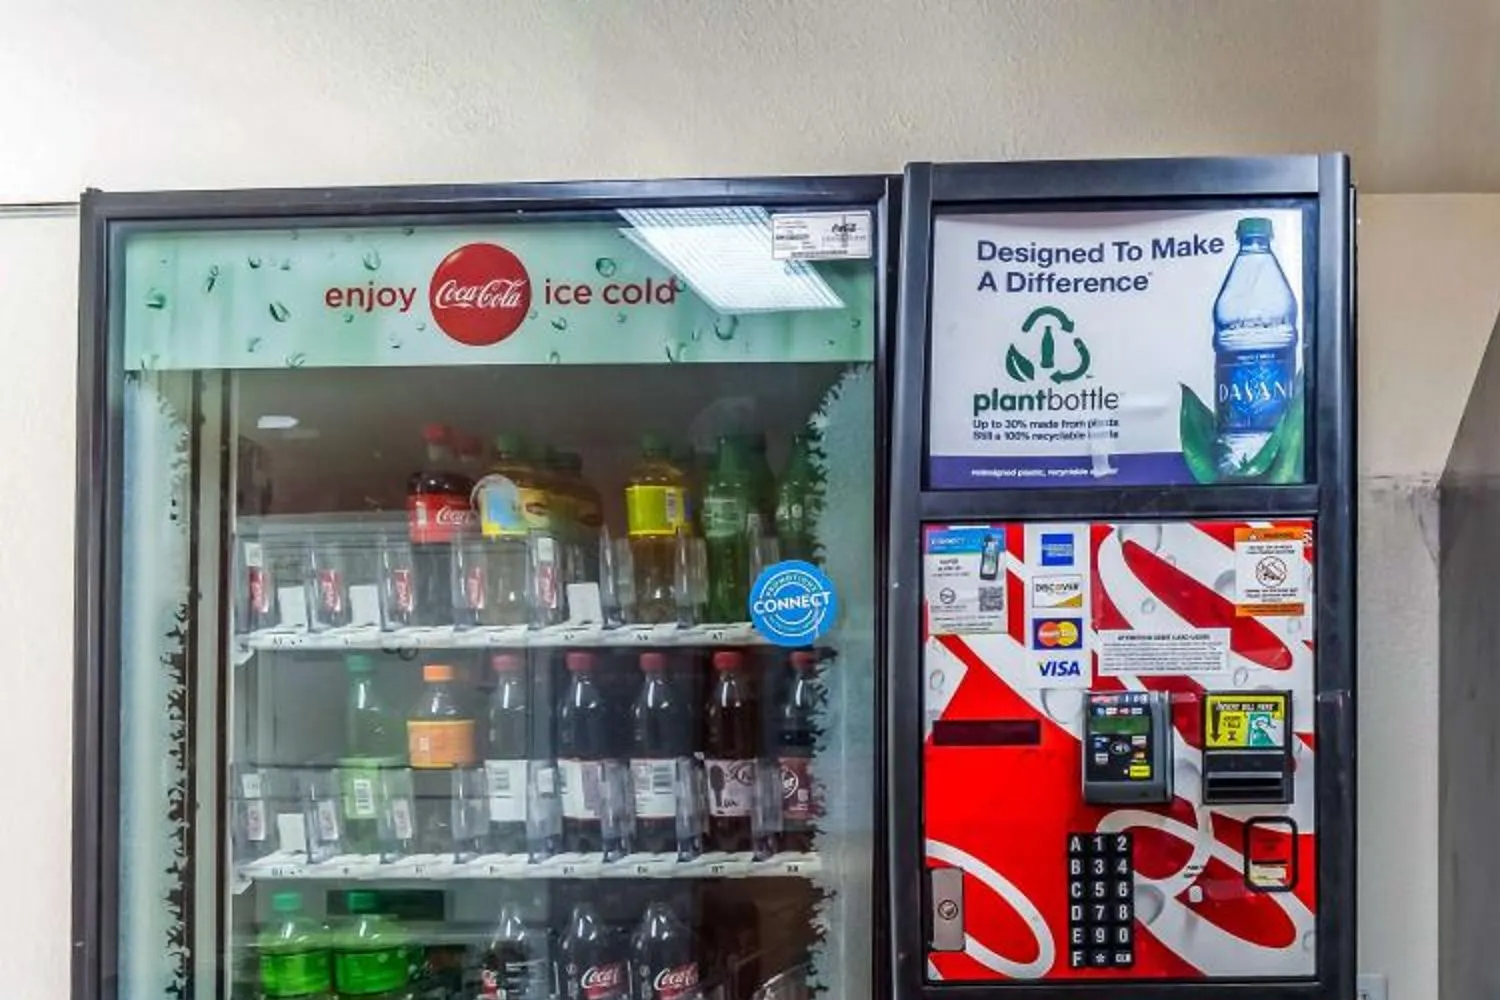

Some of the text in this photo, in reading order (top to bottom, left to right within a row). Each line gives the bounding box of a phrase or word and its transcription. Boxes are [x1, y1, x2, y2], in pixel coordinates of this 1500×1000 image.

[977, 234, 1225, 267] Designed To Make
[977, 270, 1150, 293] A Difference
[325, 281, 417, 313] enjoy
[545, 277, 677, 305] ice cold
[973, 386, 1120, 416] plantbottle
[973, 419, 988, 429] Up
[992, 419, 1001, 429] to
[1030, 419, 1058, 429] made
[753, 591, 832, 616] CONNECT
[1037, 660, 1081, 677] VISA
[1070, 835, 1127, 852] A 1 2
[1071, 859, 1128, 875] B 3 4
[1071, 881, 1128, 898] C 5 6
[1071, 905, 1128, 920] D 7 8
[1073, 928, 1129, 943] E 9 0
[1072, 951, 1082, 966] F
